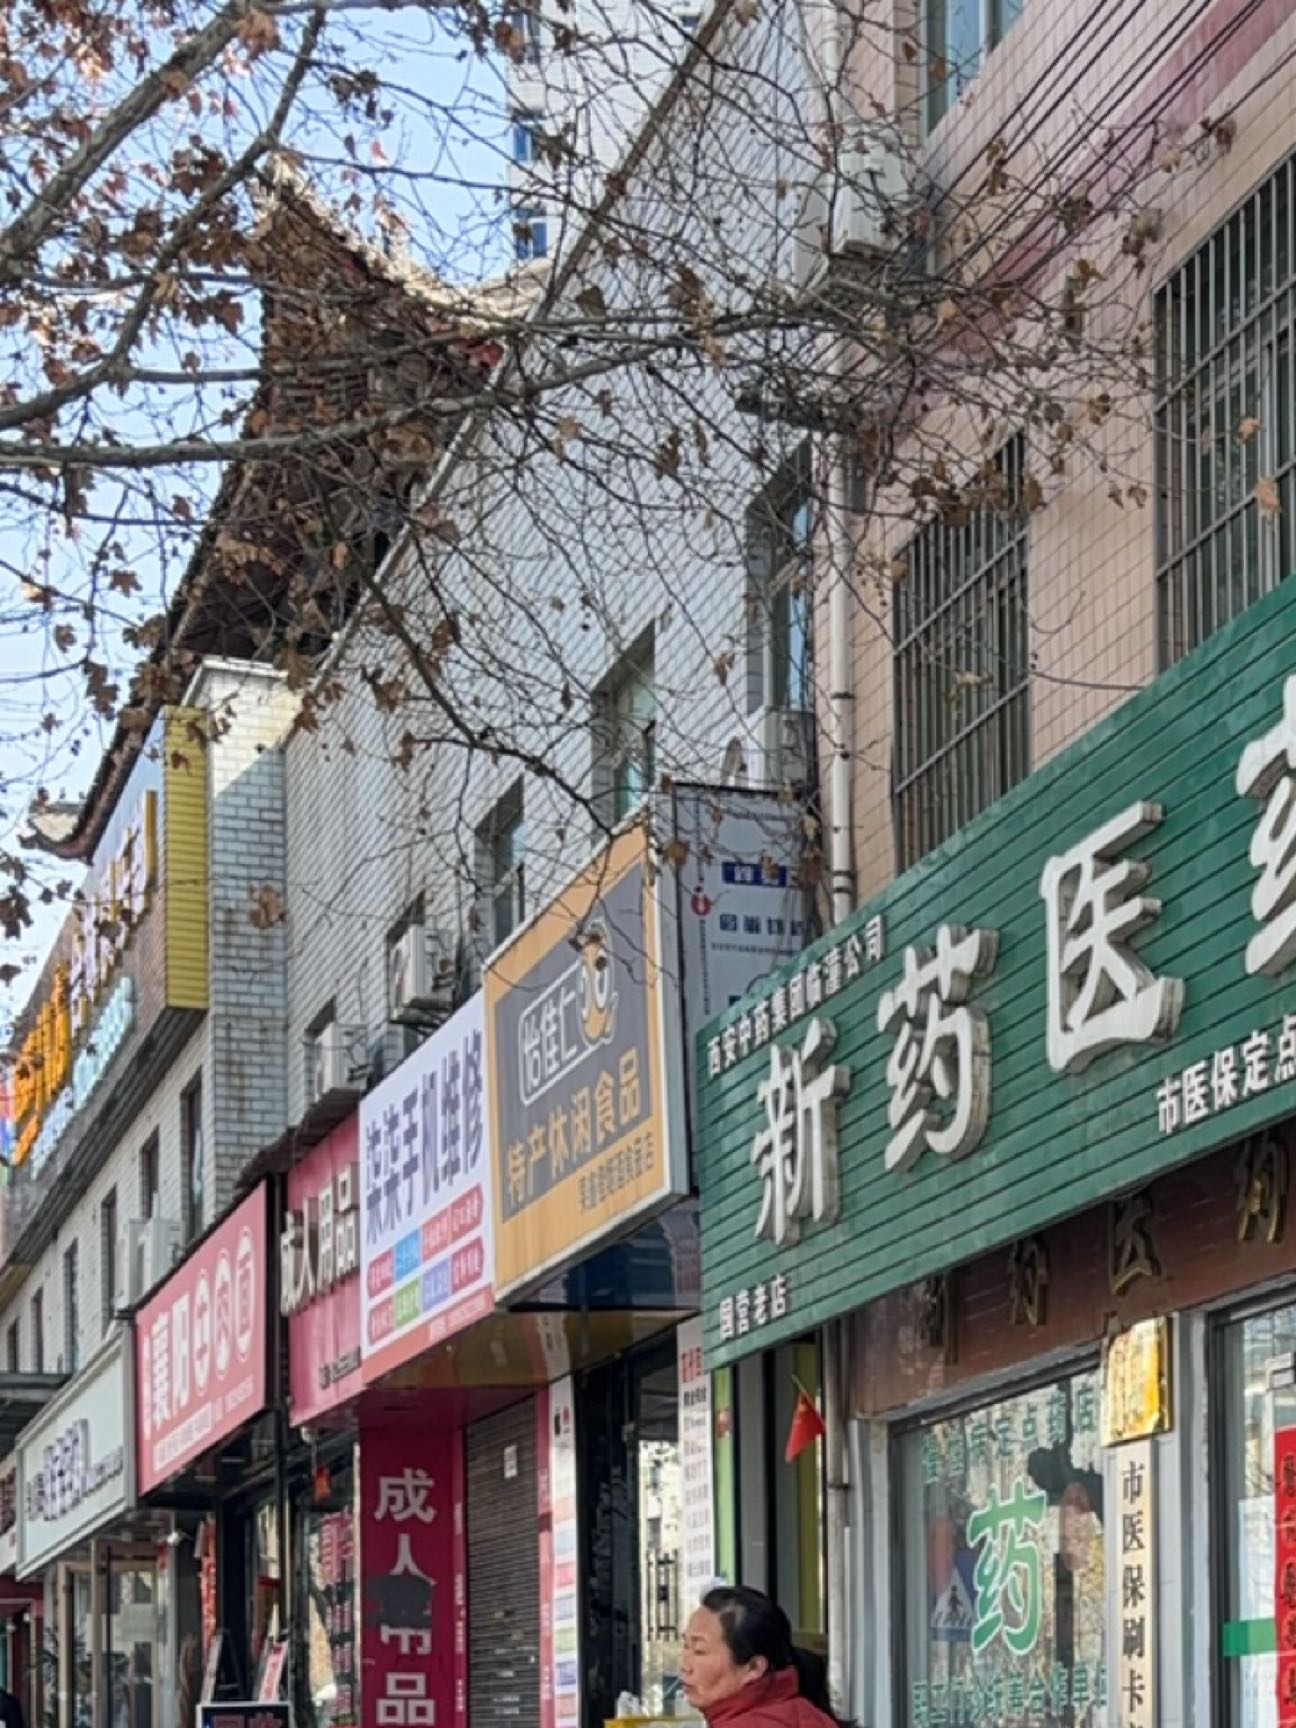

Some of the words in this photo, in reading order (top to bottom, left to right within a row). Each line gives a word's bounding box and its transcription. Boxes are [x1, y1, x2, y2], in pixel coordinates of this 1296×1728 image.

[507, 1046, 642, 1206] 特产休闲食品
[967, 1476, 1047, 1656] 药
